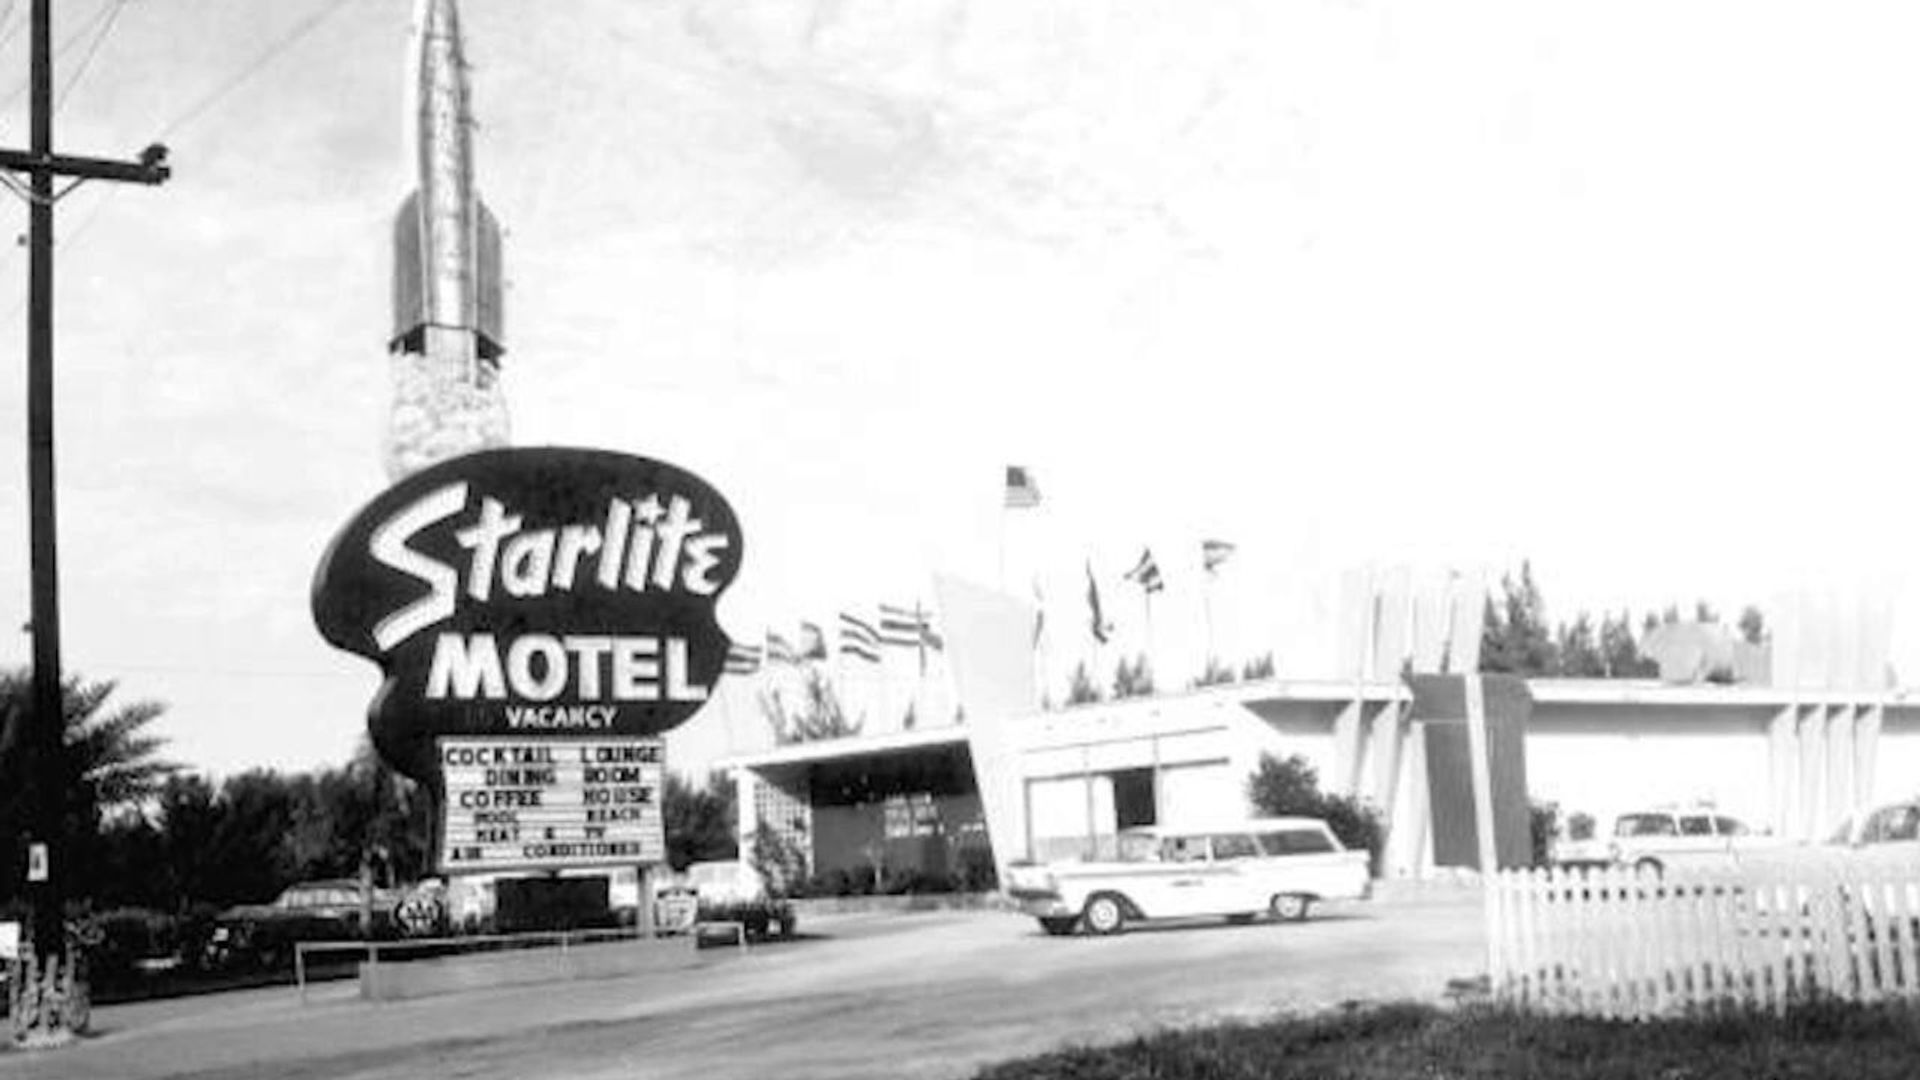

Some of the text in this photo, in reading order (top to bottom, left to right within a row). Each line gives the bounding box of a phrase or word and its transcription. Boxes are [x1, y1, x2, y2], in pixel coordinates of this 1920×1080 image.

[370, 482, 728, 651] Starlite
[426, 632, 708, 701] MOTEL
[505, 705, 618, 728] VACANCY
[446, 747, 661, 765] COCKTAIL LOUNGE
[486, 766, 640, 786] DINING ROOM
[460, 786, 651, 808] COFFEE HOUSE
